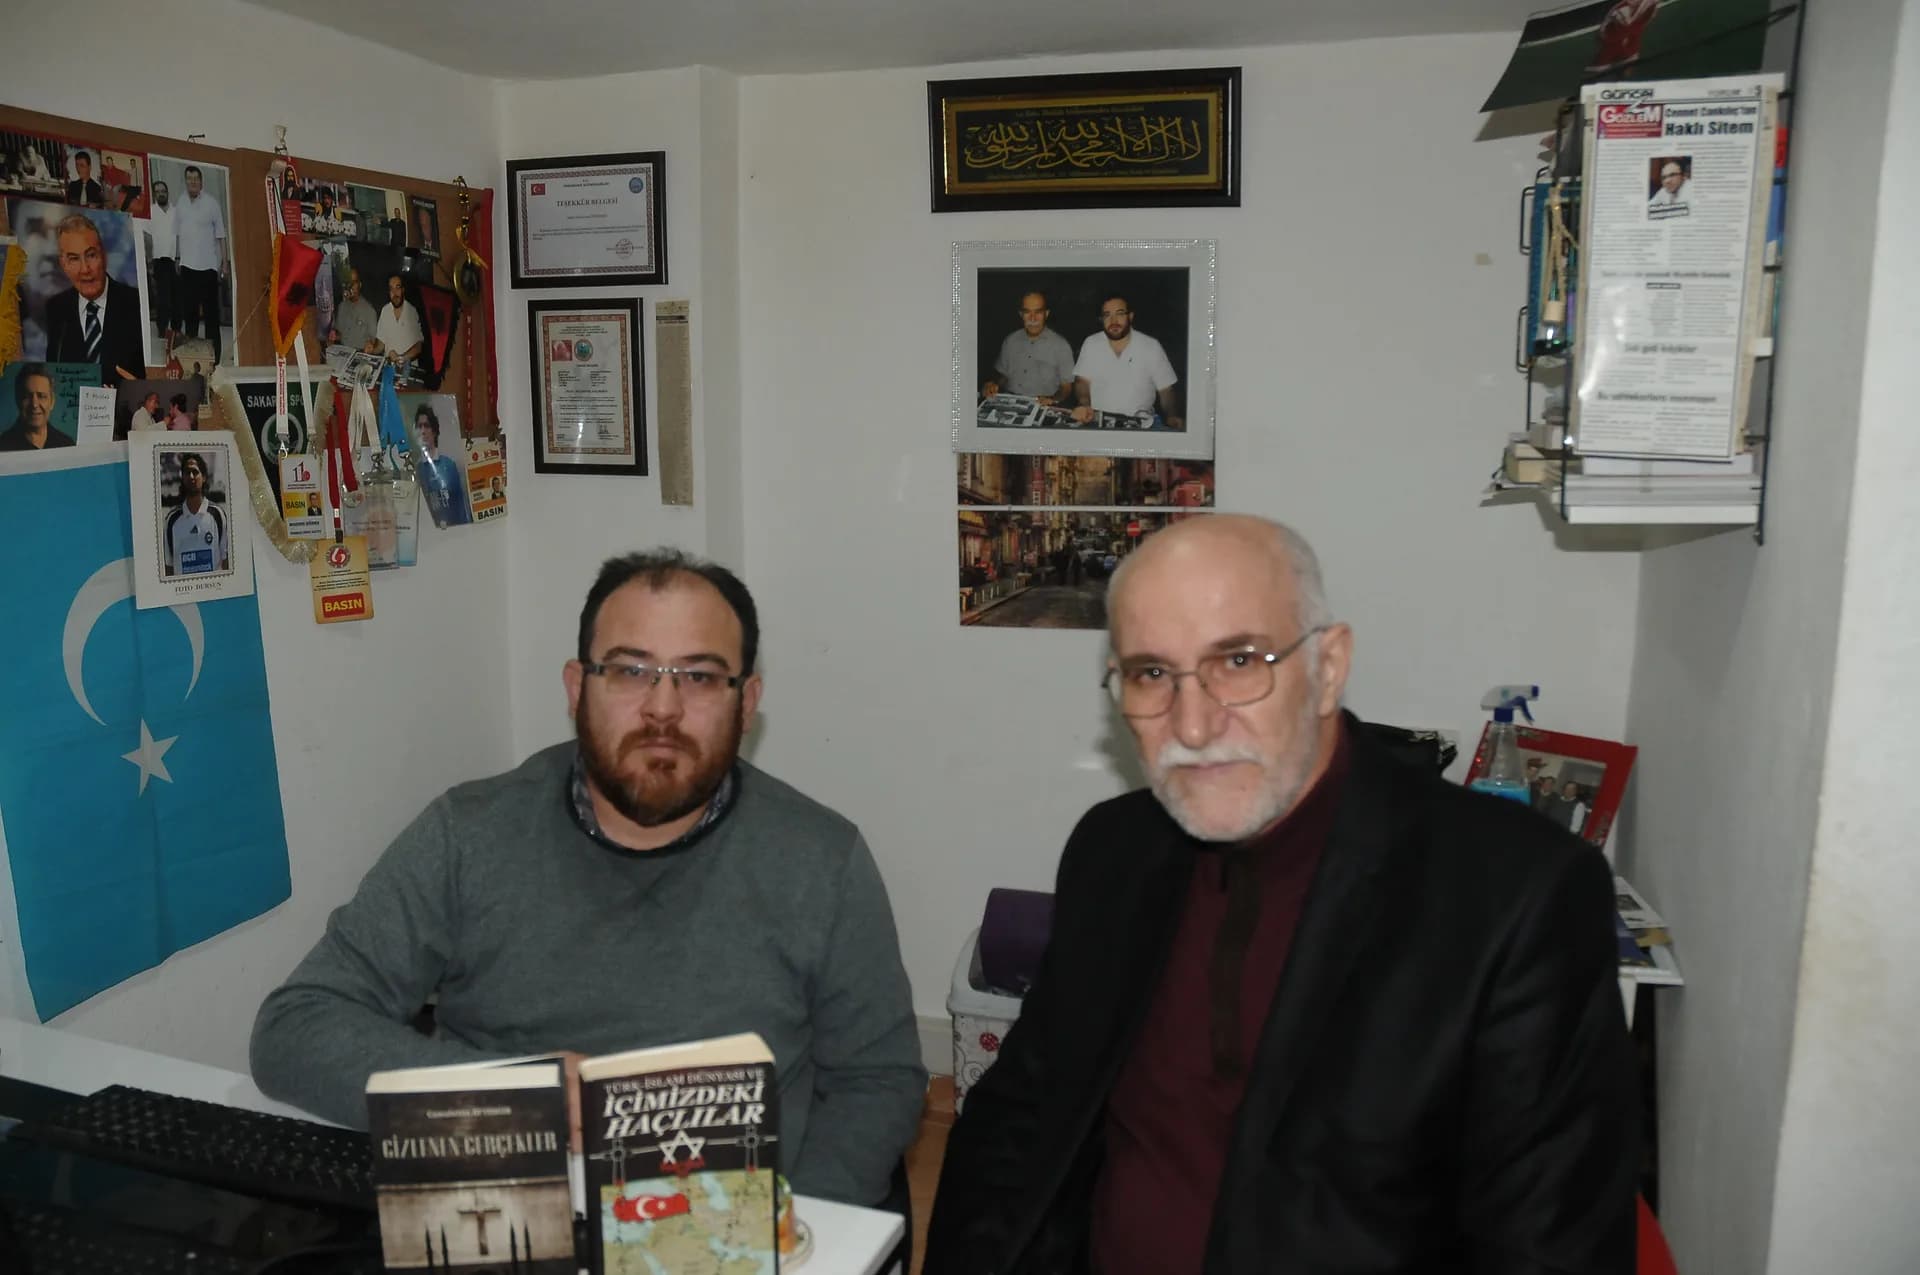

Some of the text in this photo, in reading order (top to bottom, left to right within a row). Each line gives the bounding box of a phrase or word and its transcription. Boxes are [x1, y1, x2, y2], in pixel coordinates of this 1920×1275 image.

[1664, 123, 1703, 136] Haklı
[1707, 121, 1754, 135] Sitem
[477, 506, 504, 520] BASIN
[324, 598, 363, 612] BASIN
[603, 1079, 765, 1118] İÇİMİZDEKİ
[603, 1103, 766, 1140] HAÇLILAR
